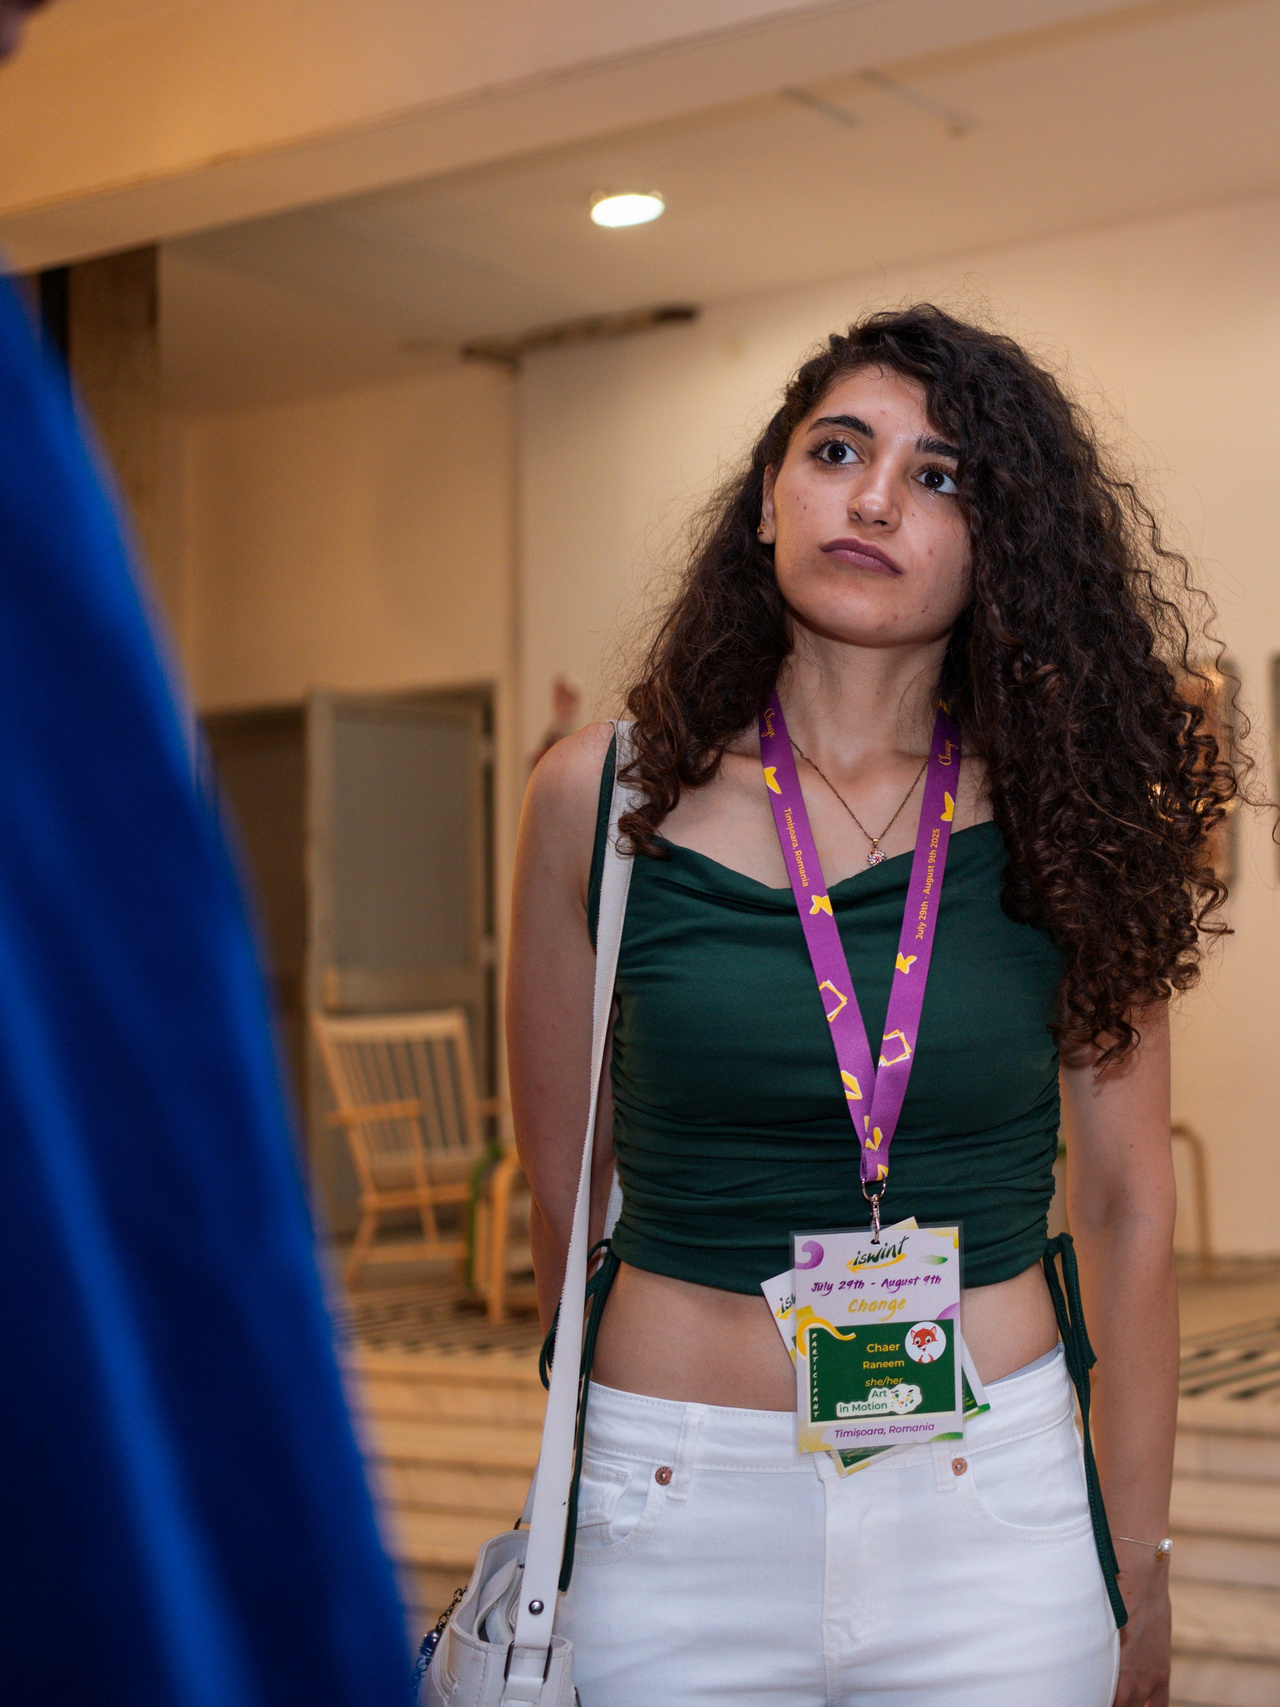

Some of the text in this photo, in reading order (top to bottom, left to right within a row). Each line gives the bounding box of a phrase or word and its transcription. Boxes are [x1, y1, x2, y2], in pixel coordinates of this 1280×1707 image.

[930, 828, 940, 848] 2025
[928, 849, 937, 864] 9th
[794, 850, 810, 887] Romania
[923, 865, 935, 895] August
[919, 901, 929, 920] 29th
[915, 921, 926, 940] July
[853, 1235, 909, 1266] iswint
[811, 1282, 834, 1296] July
[838, 1279, 865, 1291] 29th
[881, 1276, 920, 1293] August
[923, 1275, 942, 1287] 9th
[847, 1298, 907, 1322] Change
[866, 1343, 900, 1353] Chaer
[862, 1359, 905, 1370] Raneem
[811, 1332, 819, 1418] PARTICIPANT
[865, 1376, 903, 1387] she/her
[871, 1389, 888, 1398] Art
[839, 1401, 888, 1413] in Motion
[834, 1423, 935, 1438] Timișoara, Romania
